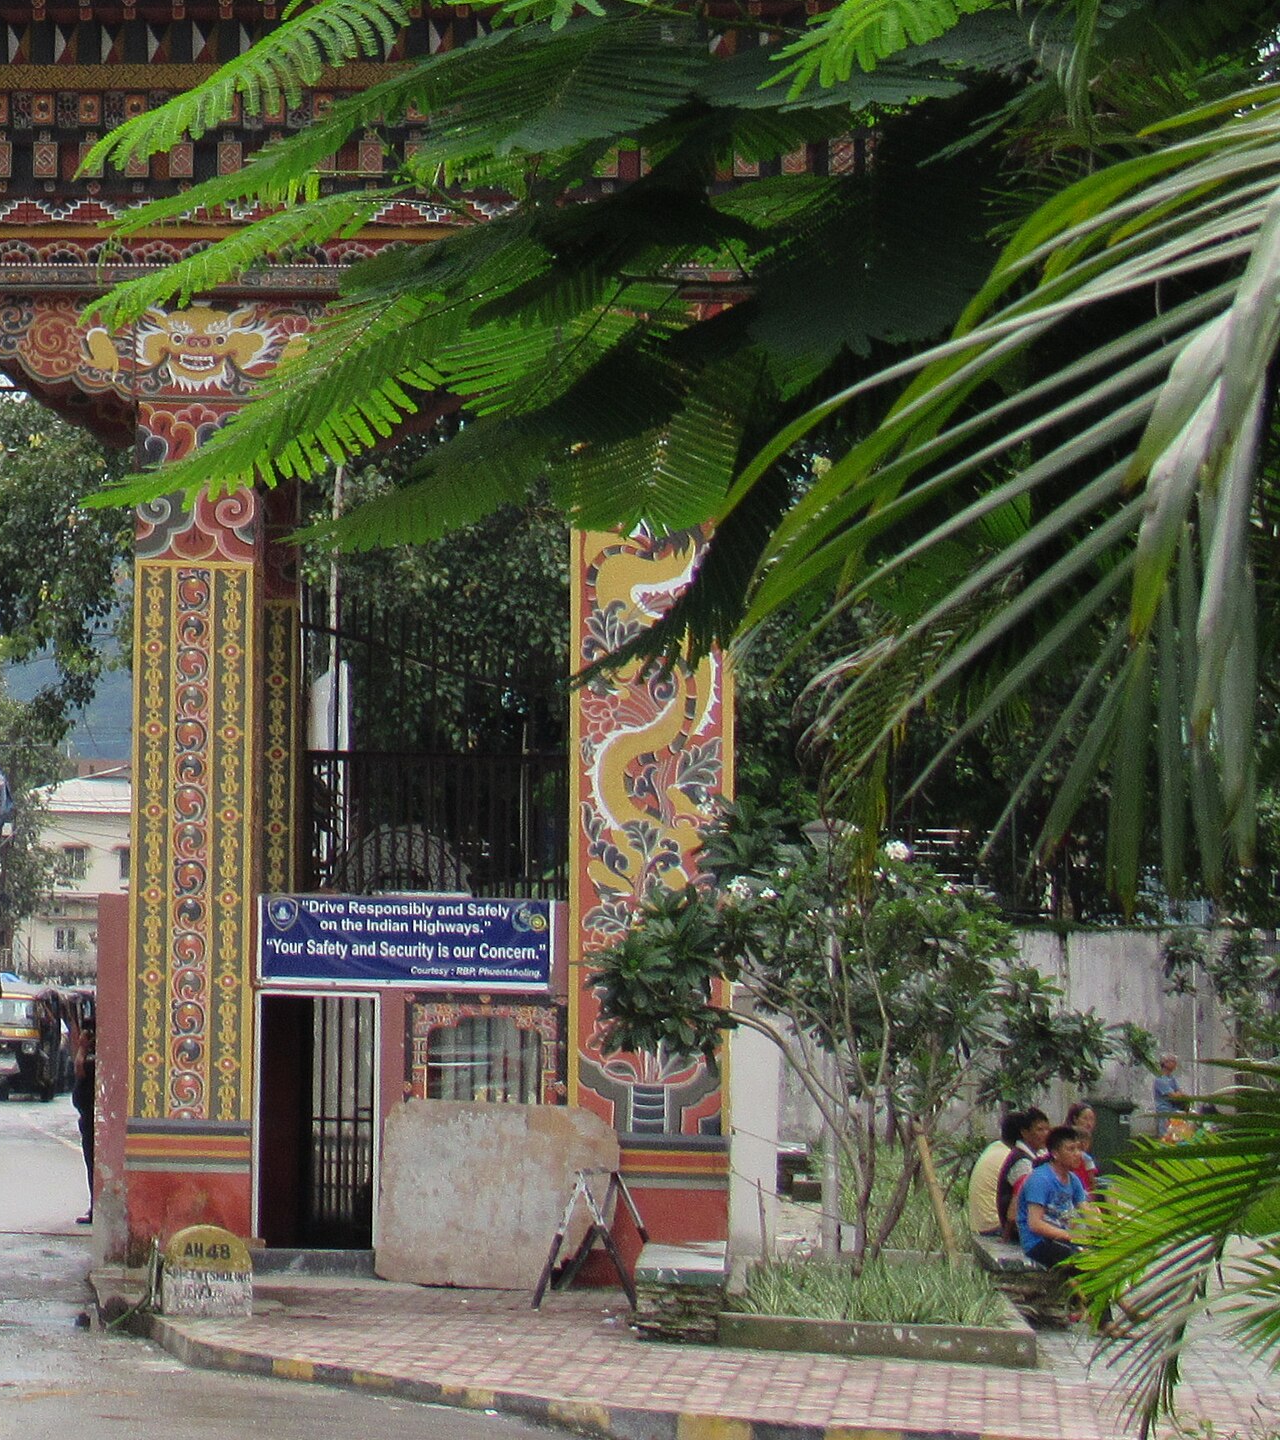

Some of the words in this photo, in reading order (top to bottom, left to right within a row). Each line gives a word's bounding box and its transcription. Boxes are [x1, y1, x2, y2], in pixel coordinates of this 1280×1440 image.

[348, 901, 434, 918] Responsibly
[437, 903, 464, 916] and
[467, 903, 510, 919] Safely
[320, 920, 338, 931] on
[341, 918, 363, 931] the
[366, 918, 409, 932] Indian
[306, 939, 348, 959] Safety
[351, 941, 377, 956] and
[379, 941, 435, 961] Security
[437, 942, 450, 957] is
[453, 945, 477, 958] our
[410, 966, 449, 977] Courtesy
[184, 1242, 204, 1258] AH
[206, 1243, 231, 1260] 48
